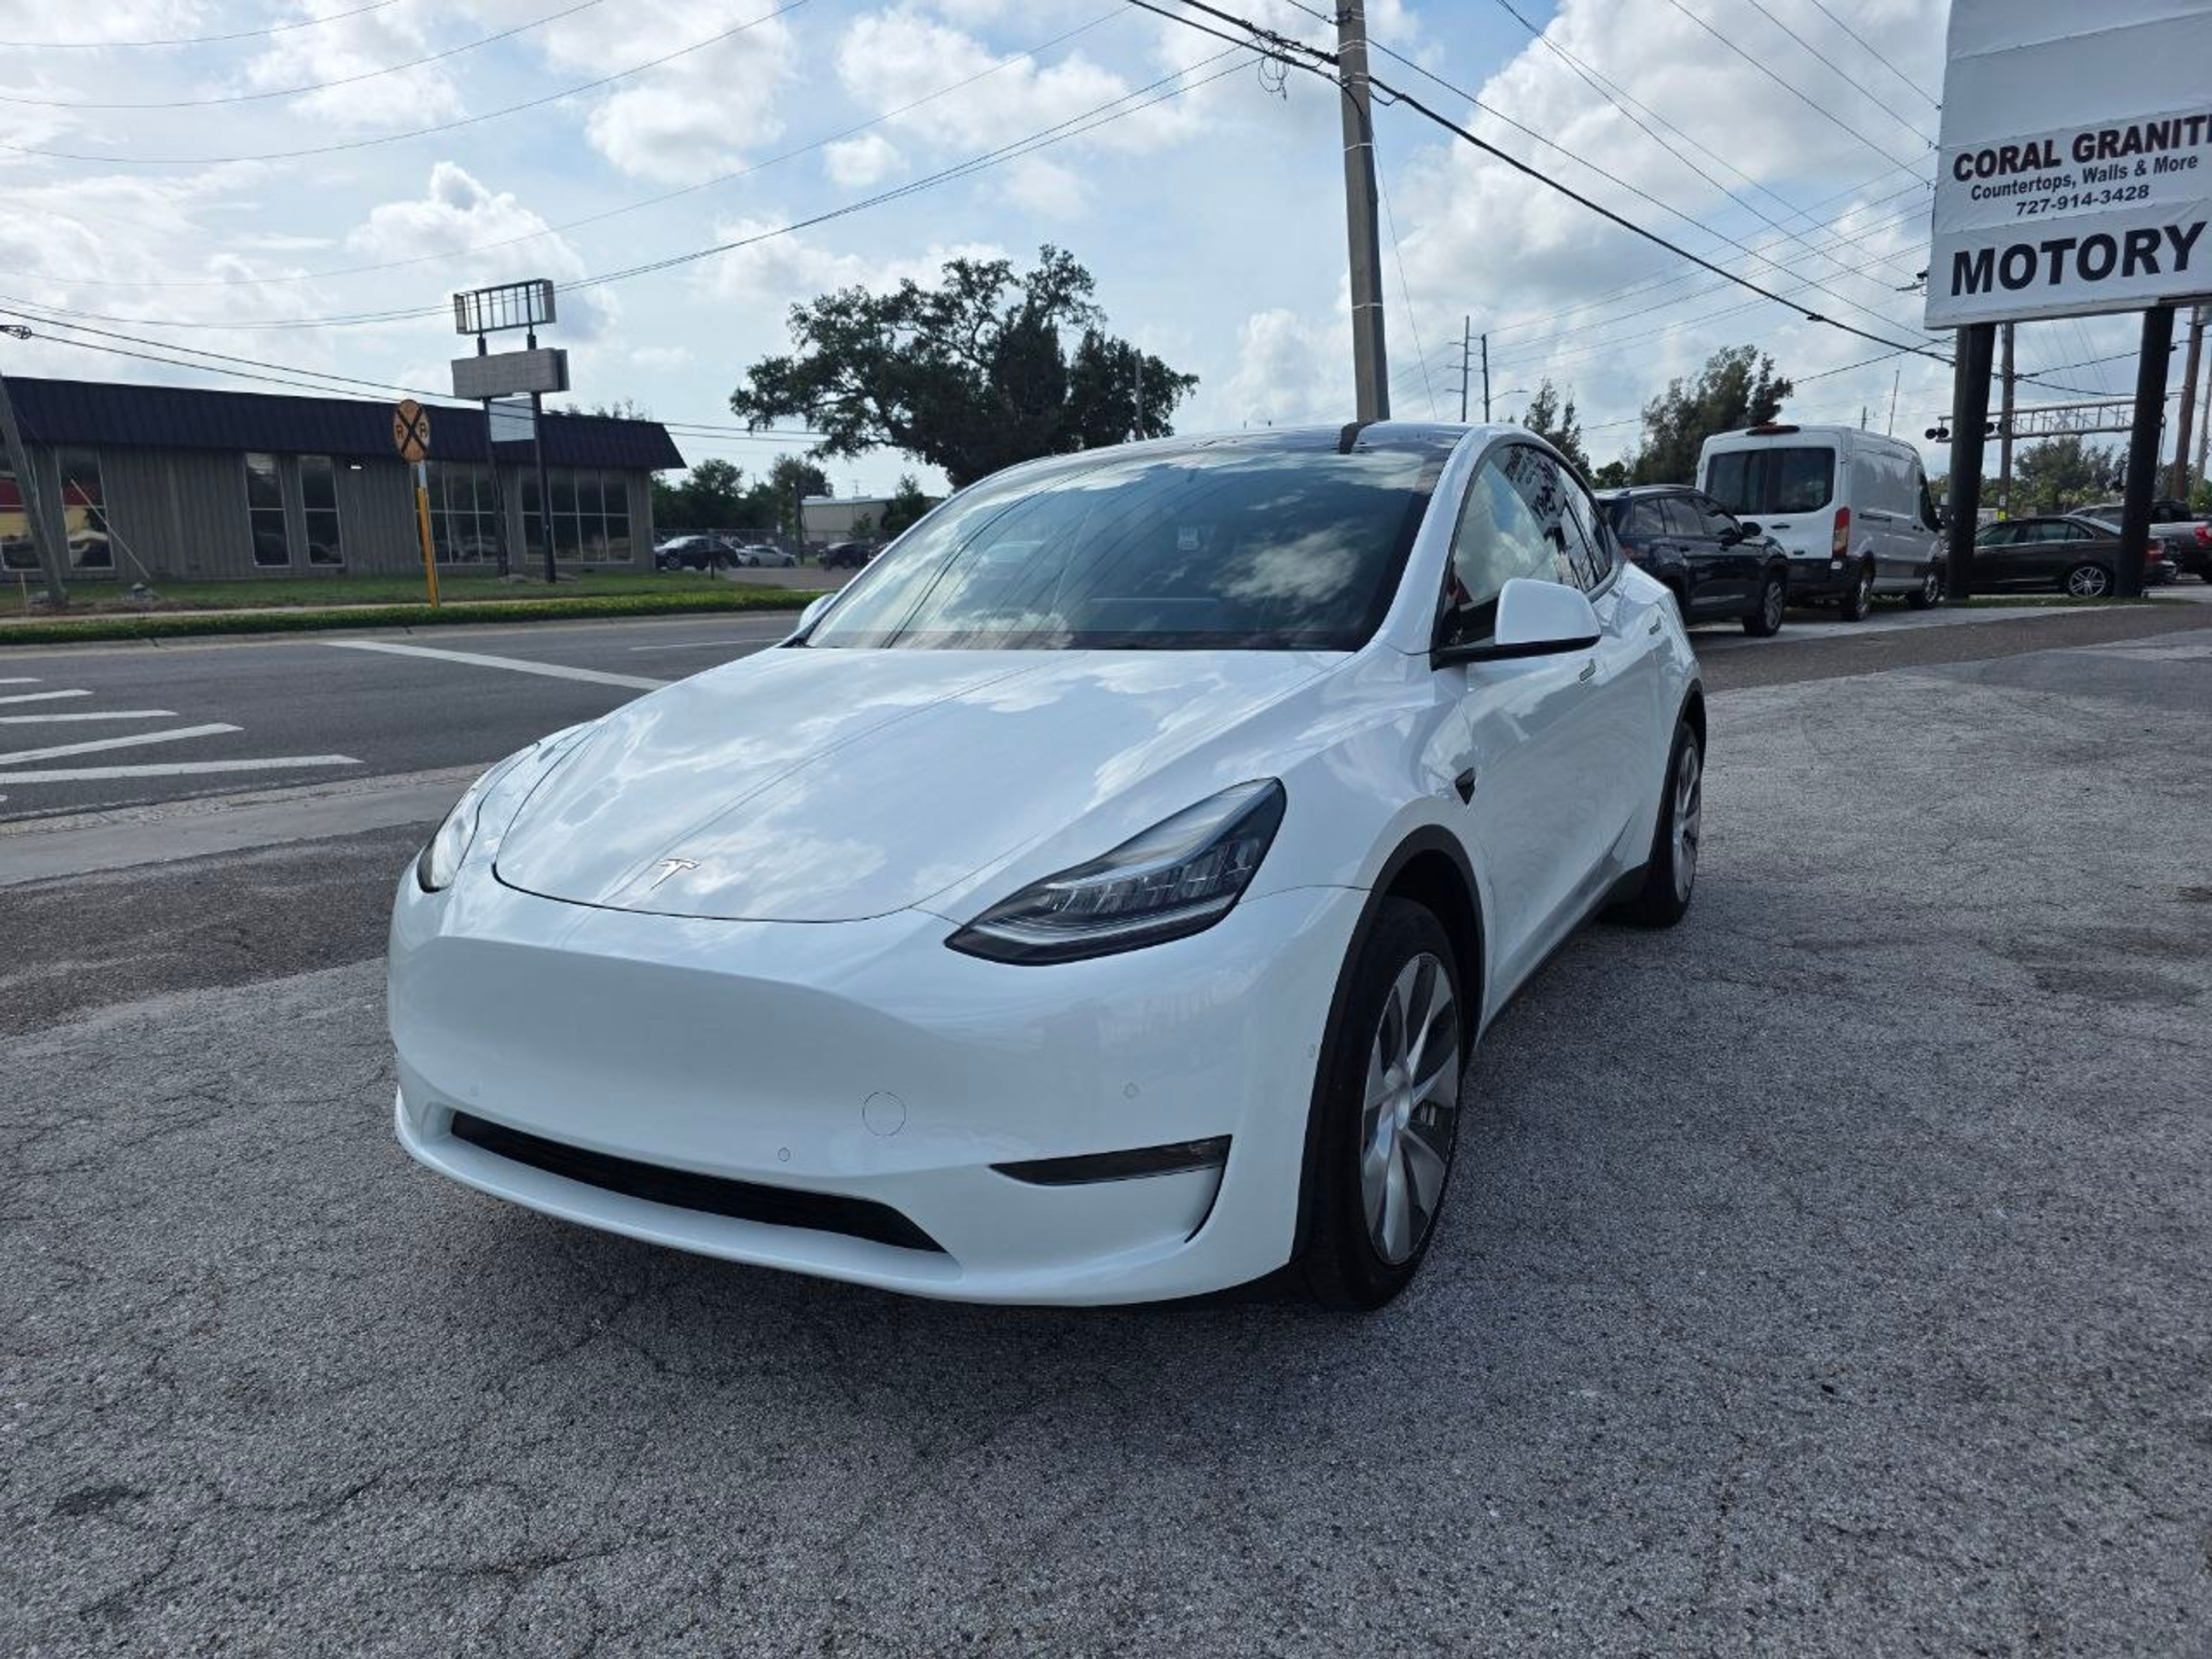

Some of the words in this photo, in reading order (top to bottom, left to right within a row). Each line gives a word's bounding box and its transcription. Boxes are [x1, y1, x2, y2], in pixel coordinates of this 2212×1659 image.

[1953, 139, 2062, 181] CORAL
[1971, 174, 2076, 200] Countertops,
[2082, 164, 2128, 184] Walls
[2134, 159, 2146, 177] &
[2153, 155, 2198, 175] More
[2016, 184, 2149, 216] 727-914-3428
[1950, 221, 2207, 297] MOTORY
